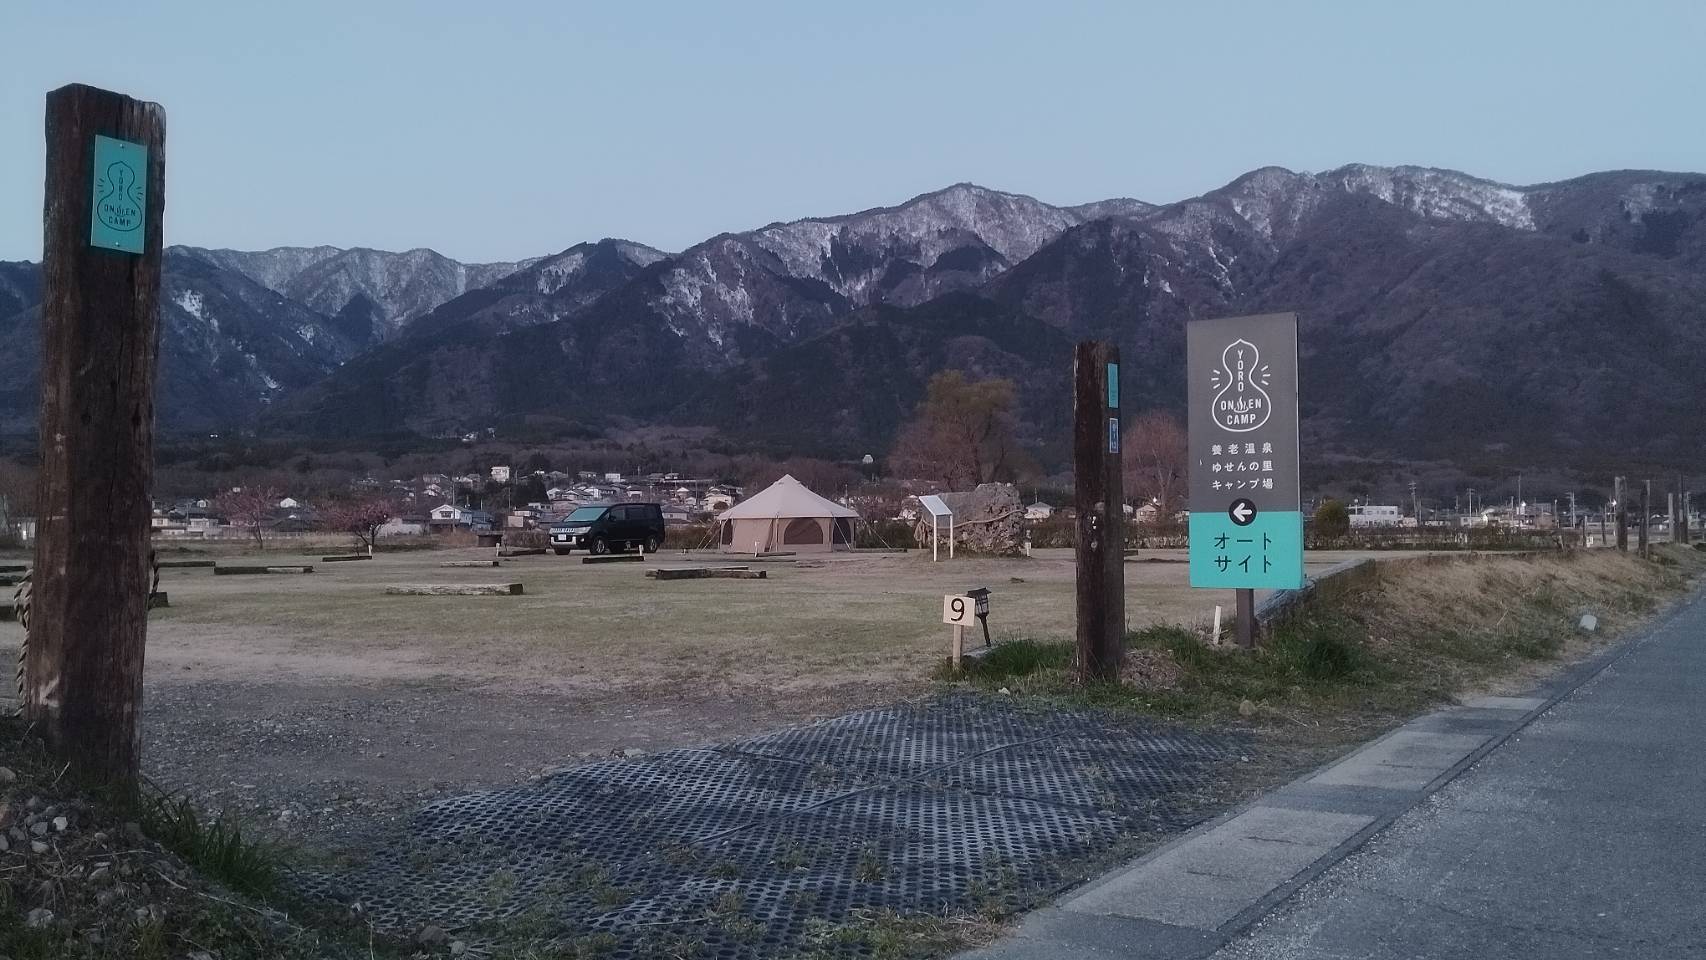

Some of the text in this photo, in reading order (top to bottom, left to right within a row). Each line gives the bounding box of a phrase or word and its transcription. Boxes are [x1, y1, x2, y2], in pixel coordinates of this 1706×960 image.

[1226, 413, 1256, 425] CAMP
[1211, 442, 1273, 456] 養老温泉
[1212, 460, 1274, 473] ゆせんの里
[1212, 478, 1274, 490] キャンプ場
[1213, 532, 1272, 551] オート
[1213, 555, 1272, 573] サイト
[951, 598, 965, 621] 9
